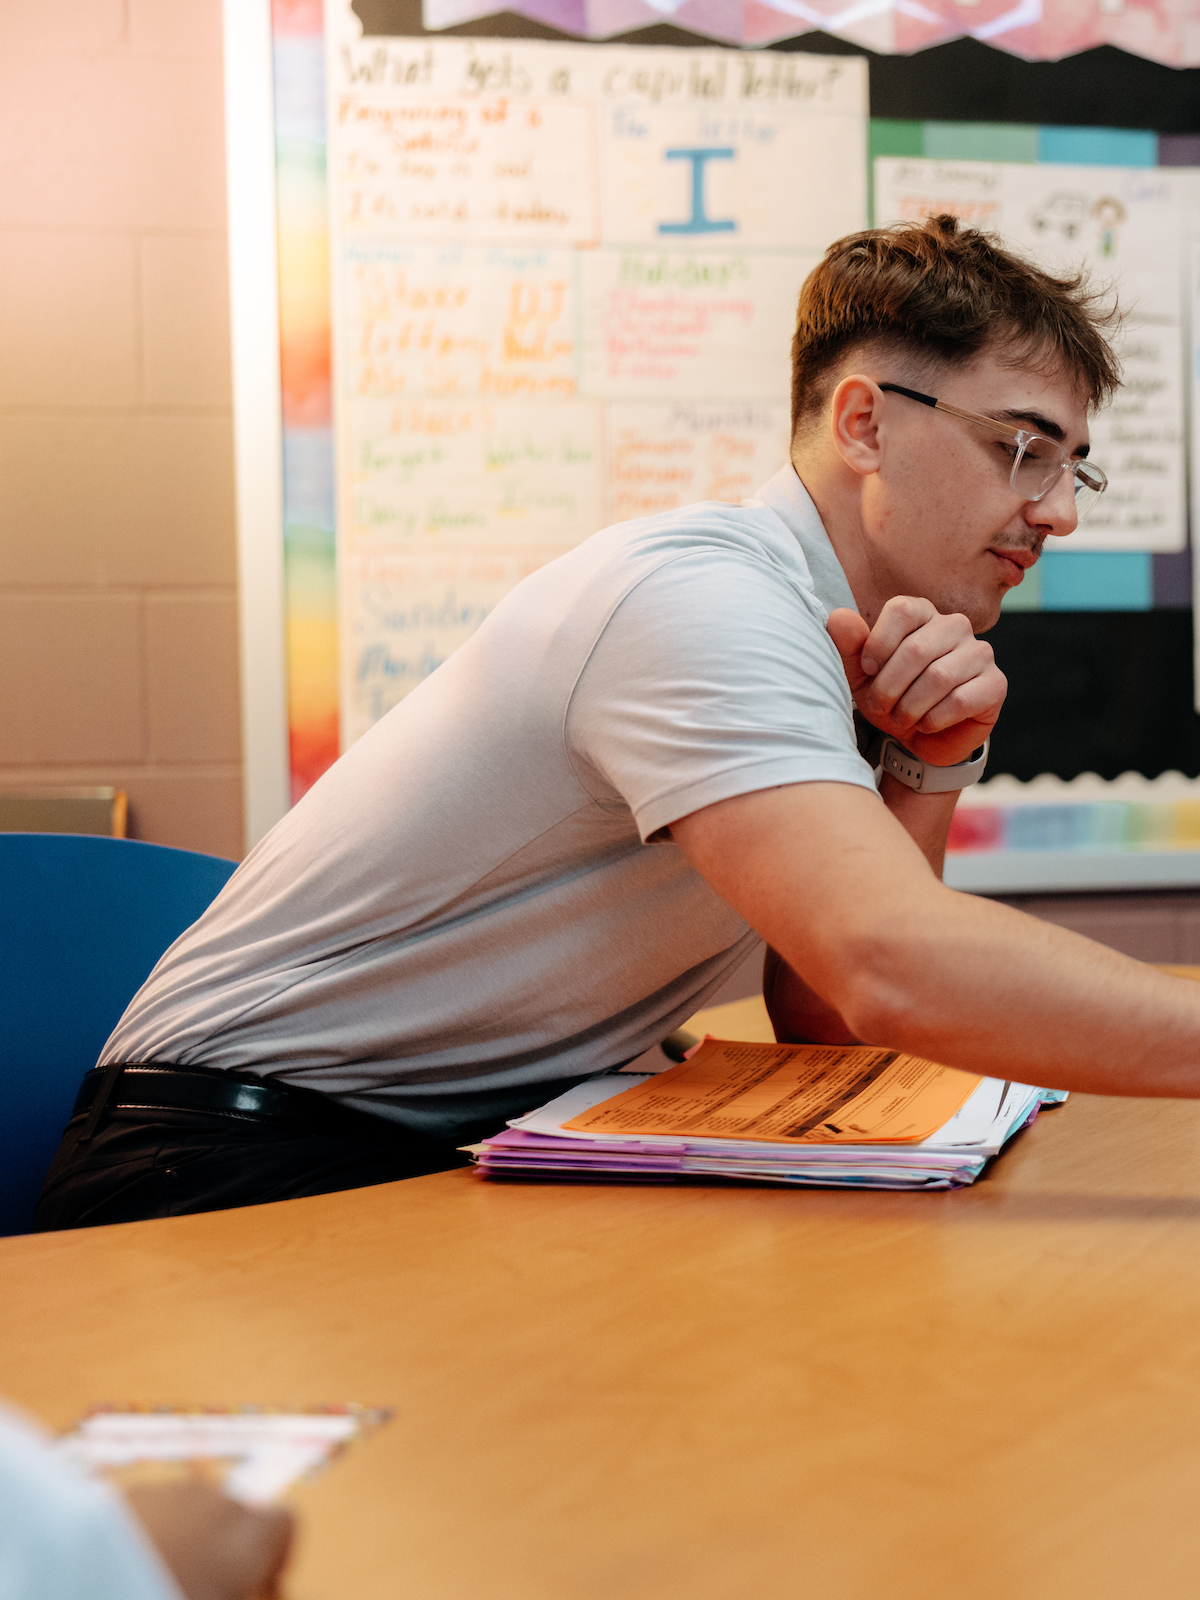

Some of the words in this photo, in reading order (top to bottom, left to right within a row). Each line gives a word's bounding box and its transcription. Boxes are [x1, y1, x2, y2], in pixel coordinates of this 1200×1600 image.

[345, 44, 437, 93] What
[463, 52, 532, 96] gets
[547, 68, 573, 95] a
[603, 60, 725, 103] capital
[739, 60, 844, 102] letter?
[480, 96, 512, 124] of
[656, 147, 738, 234] I
